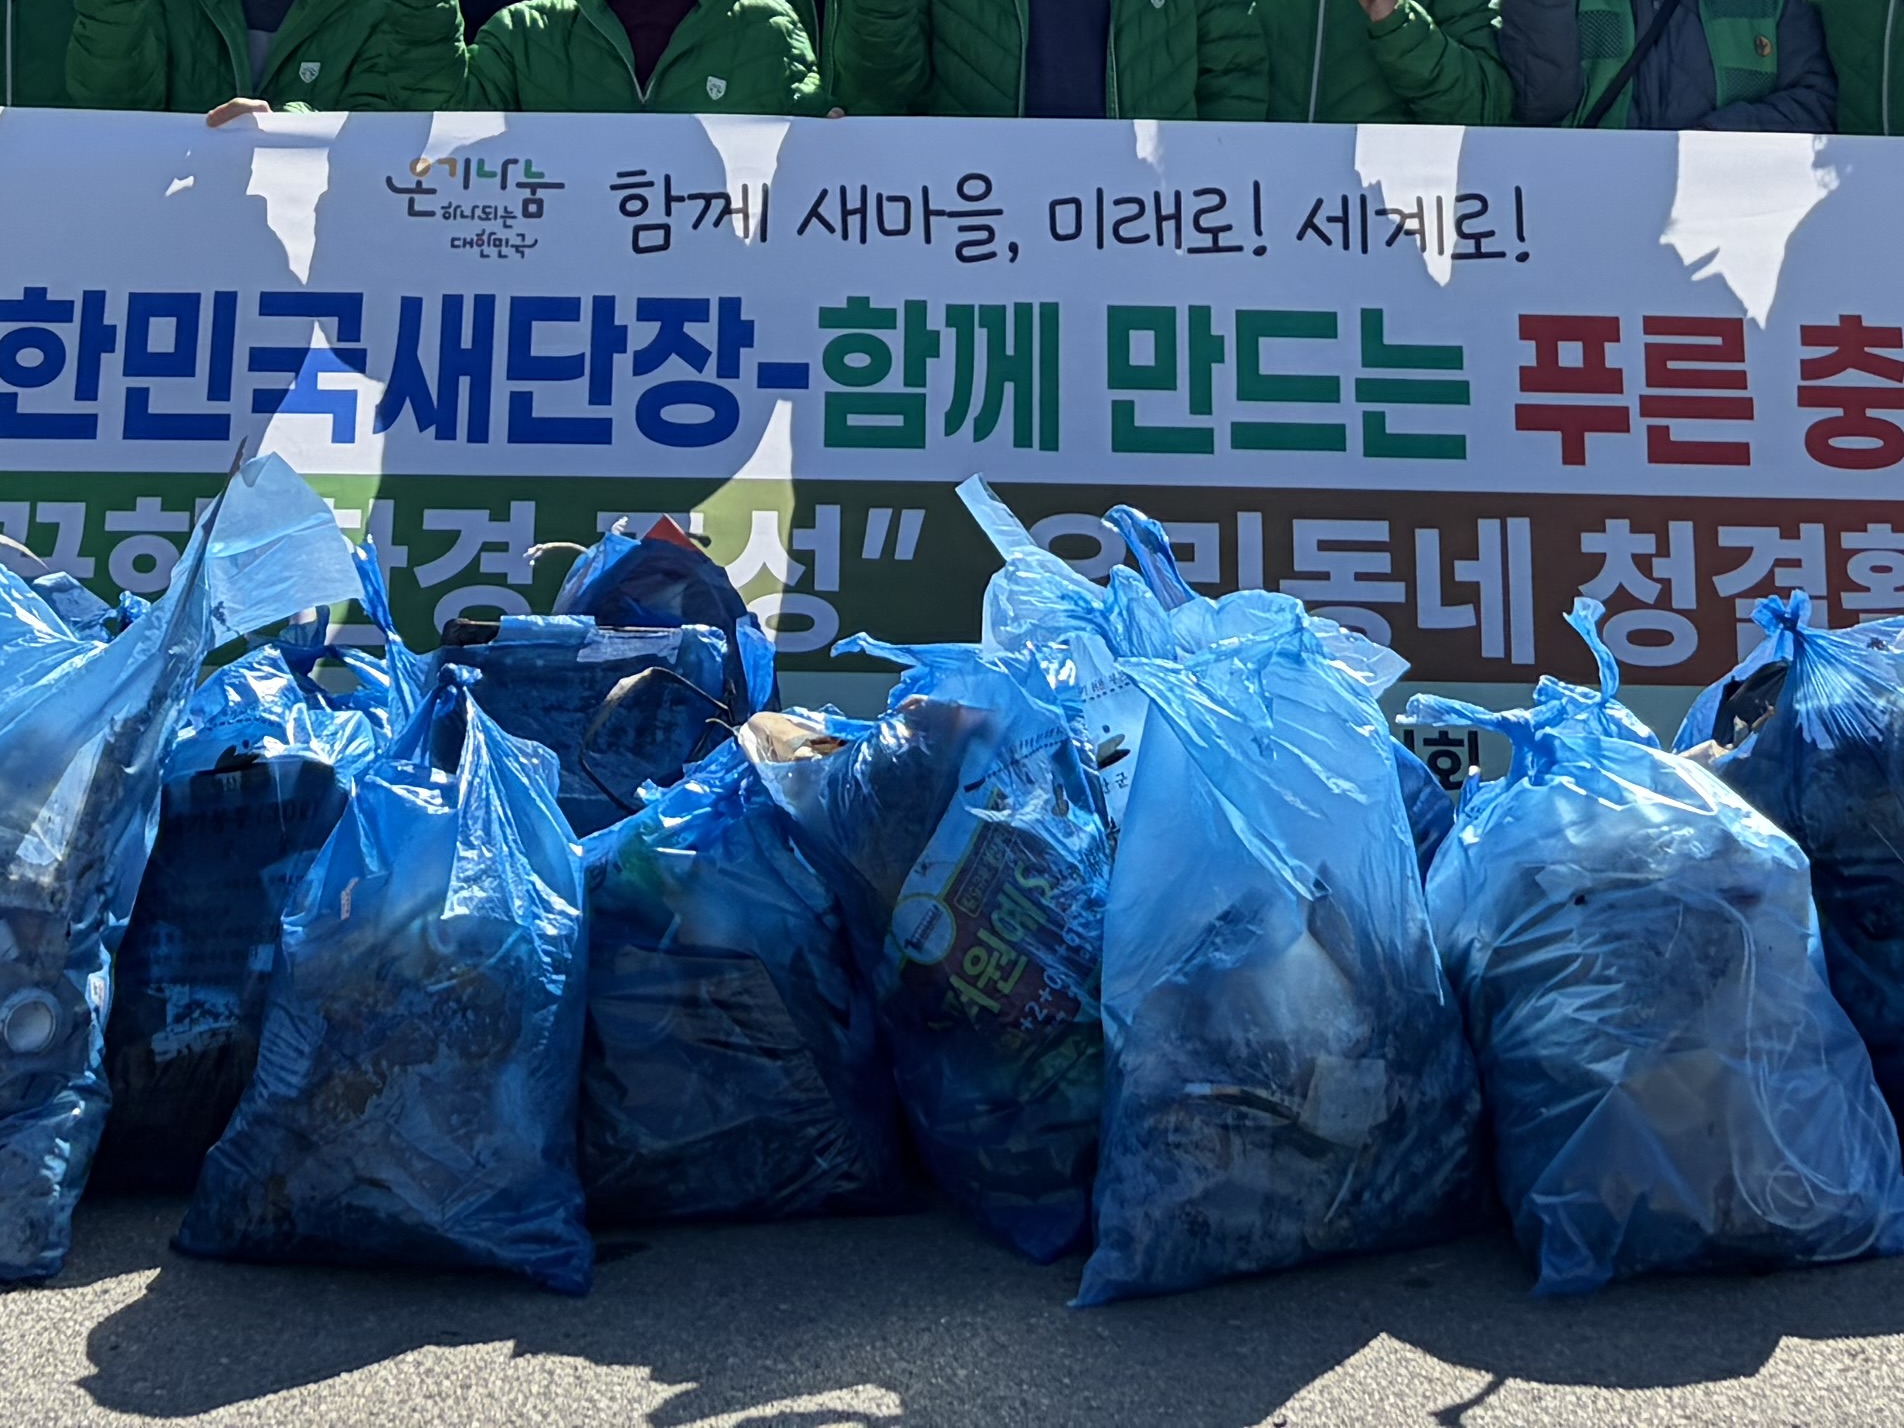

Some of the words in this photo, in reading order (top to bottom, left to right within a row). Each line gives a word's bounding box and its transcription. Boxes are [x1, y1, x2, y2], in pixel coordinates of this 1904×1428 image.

[385, 157, 566, 220] 온기나눔
[440, 204, 518, 228] 하나되는
[608, 169, 770, 256] 함께
[796, 172, 1020, 263] 새마을,
[1048, 179, 1269, 257] 미래로!
[1295, 185, 1531, 263] 세계로!
[449, 229, 539, 259] 대한민국
[1106, 304, 1471, 461] 만드는
[1513, 313, 1755, 467] 푸른
